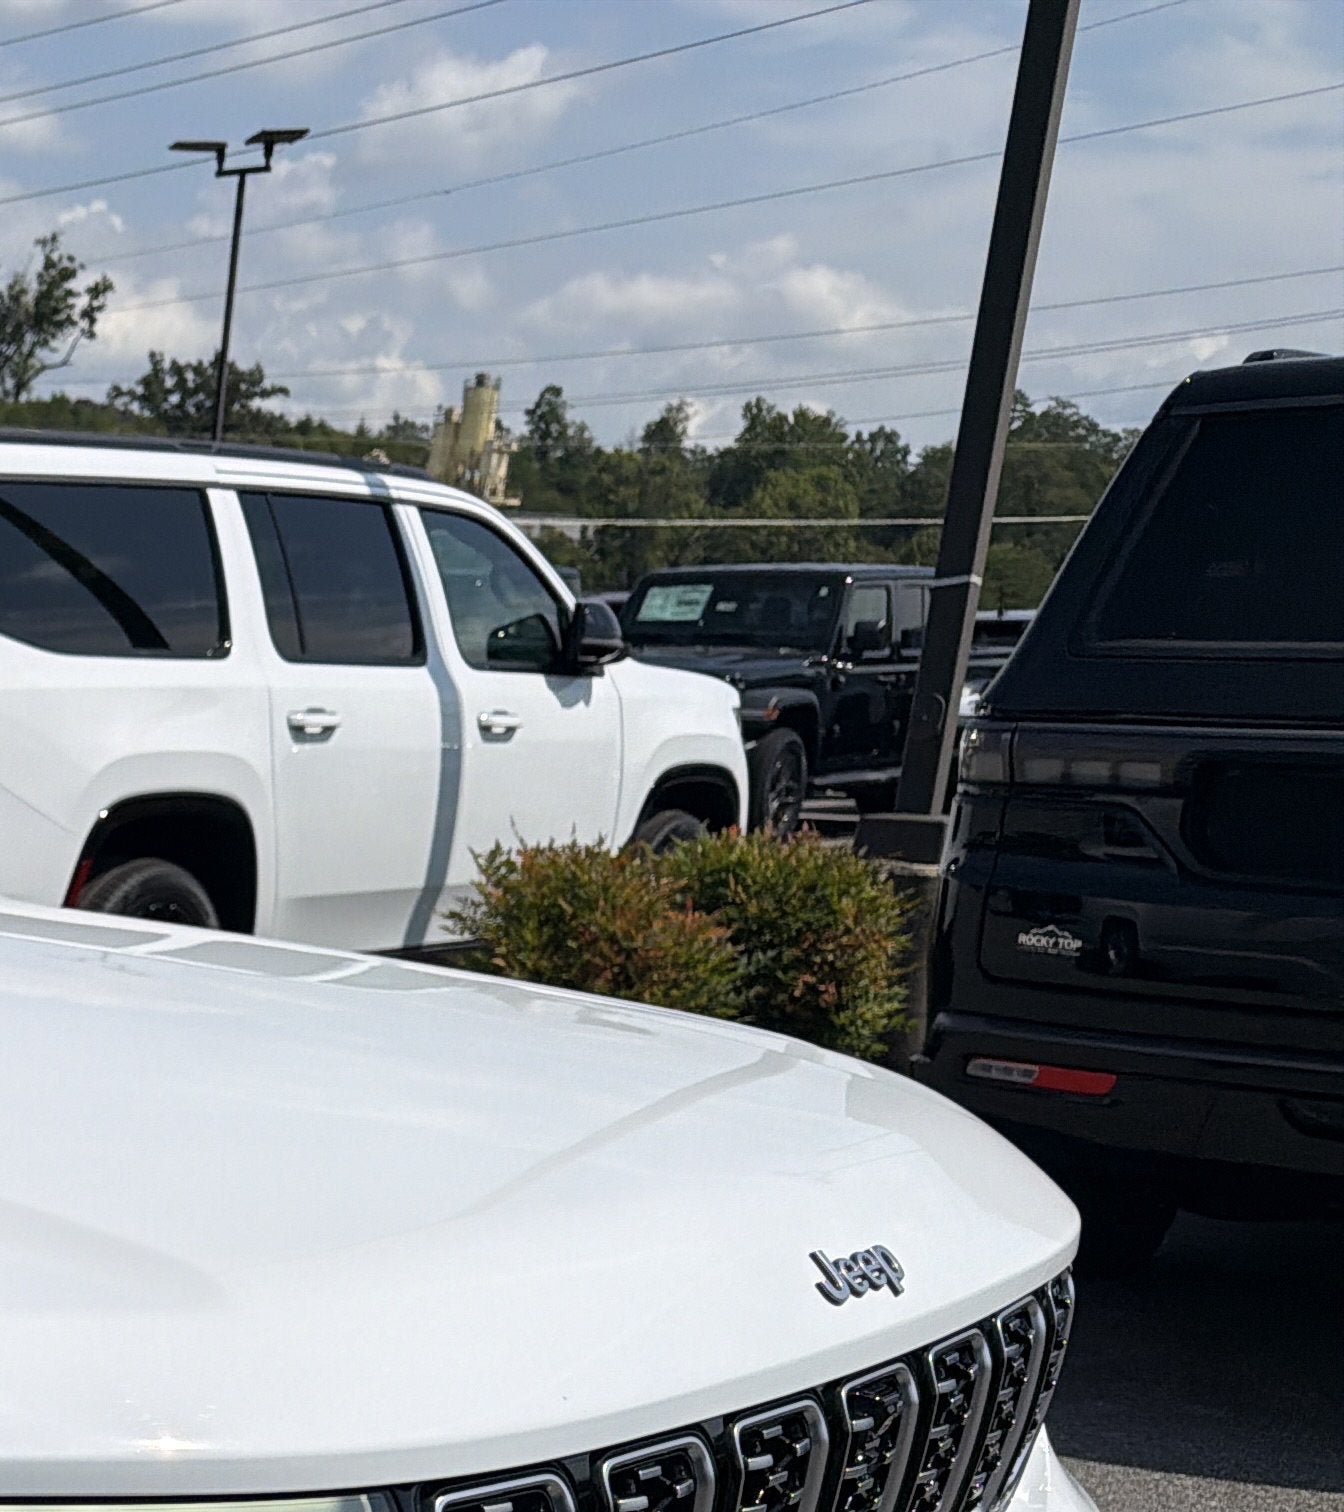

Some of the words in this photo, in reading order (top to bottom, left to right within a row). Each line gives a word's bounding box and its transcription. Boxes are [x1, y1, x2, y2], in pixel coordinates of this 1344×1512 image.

[1017, 932, 1056, 948] ROCKY
[1057, 937, 1083, 950] TOP
[809, 1245, 905, 1306] Jeep
